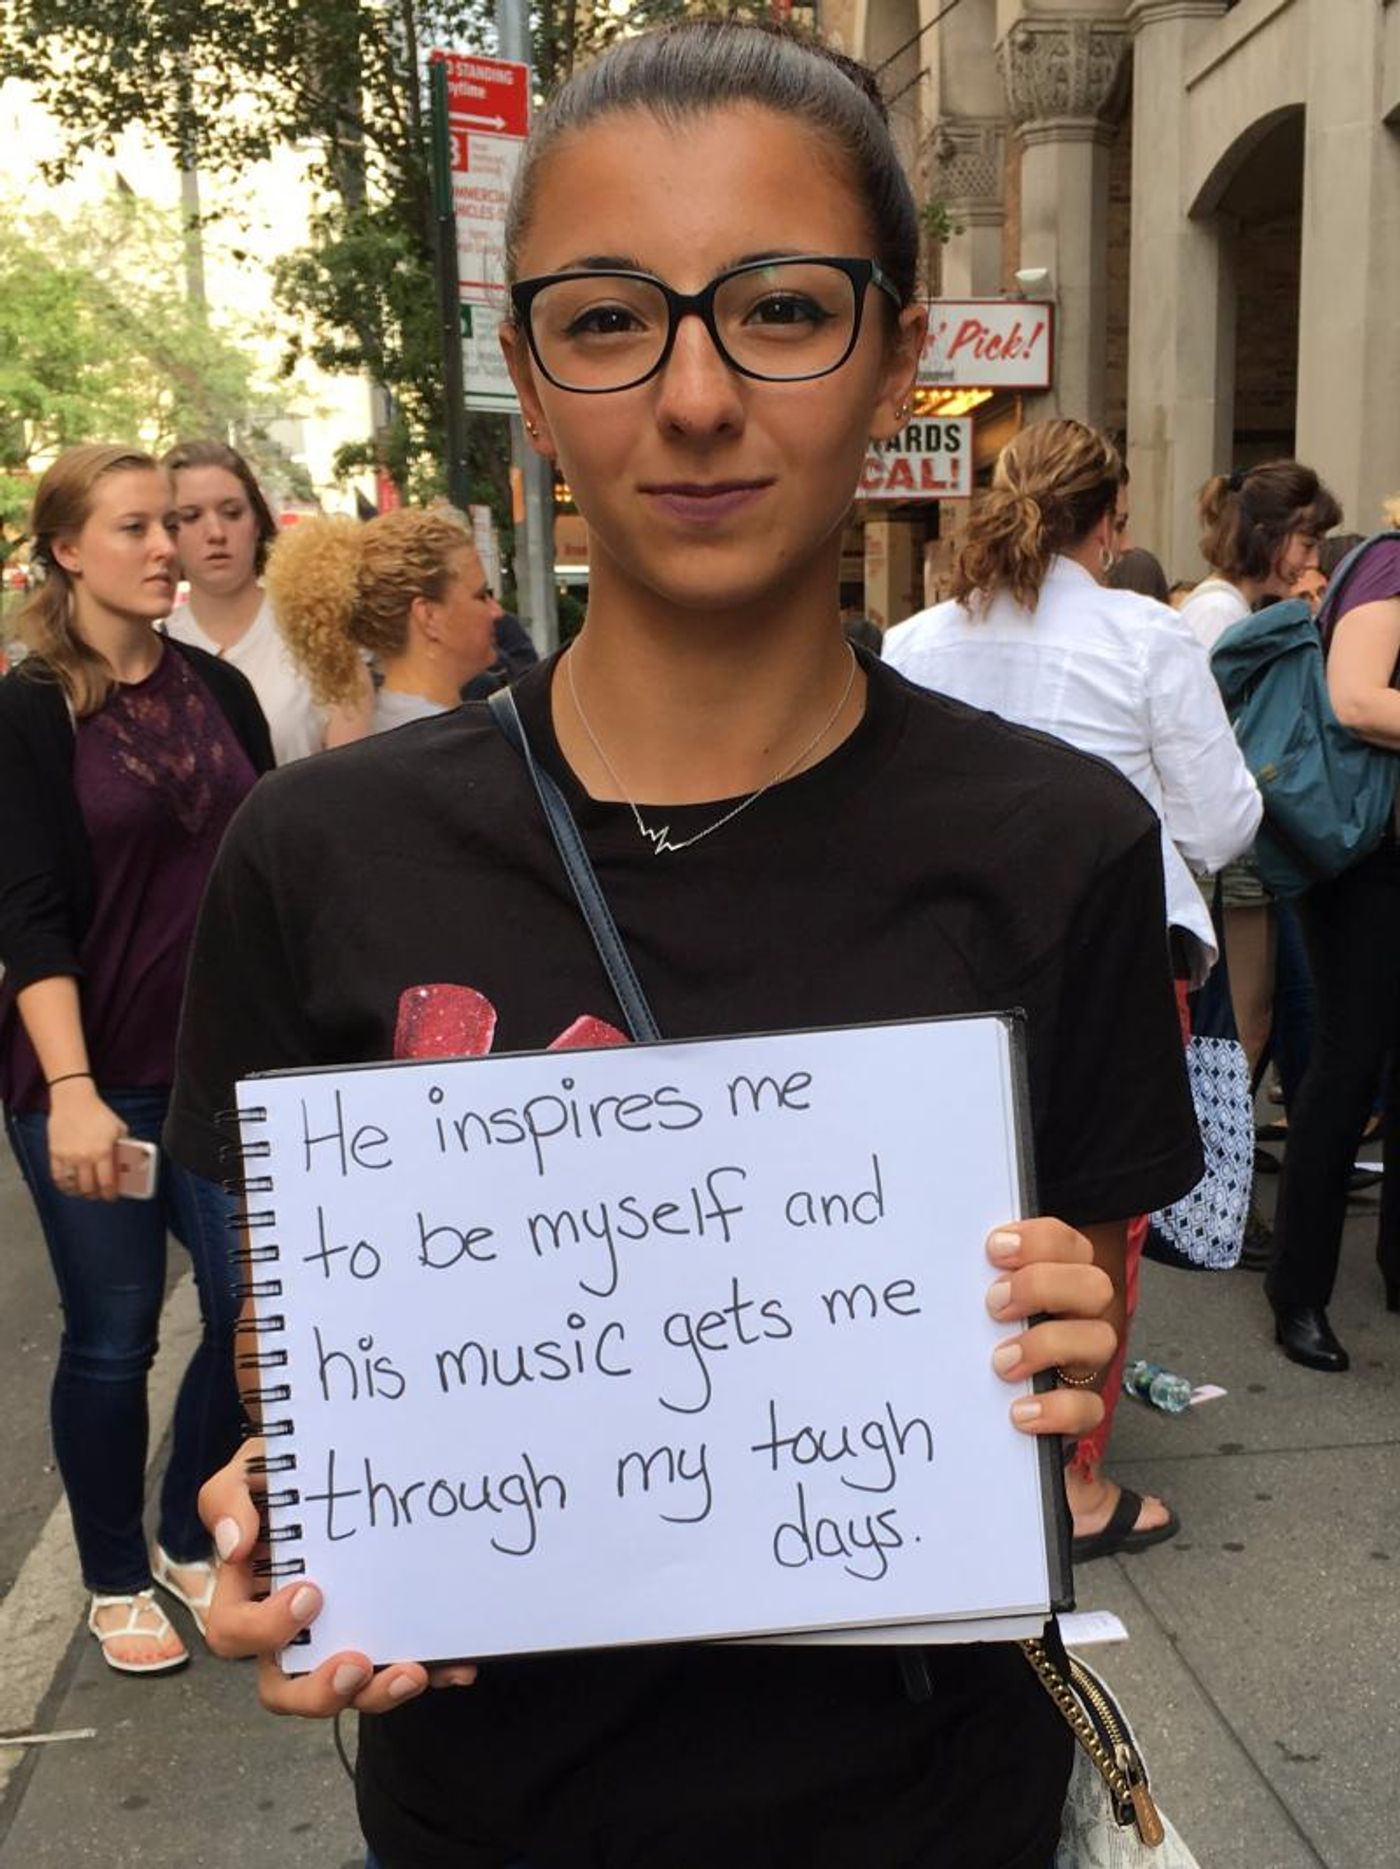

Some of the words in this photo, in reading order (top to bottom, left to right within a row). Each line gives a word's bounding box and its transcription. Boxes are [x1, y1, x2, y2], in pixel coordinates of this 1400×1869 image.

[456, 61, 514, 86] STANDING
[946, 318, 1045, 361] Pick!
[859, 457, 961, 490] CAL!
[877, 423, 961, 453] ARDS
[302, 1089, 393, 1177] He
[428, 1077, 704, 1177] inspires
[727, 1071, 813, 1117] me
[302, 1205, 381, 1280] to
[416, 1211, 497, 1270] be
[527, 1166, 747, 1298] myself
[785, 1153, 885, 1227] and
[312, 1326, 406, 1402] his
[435, 1312, 632, 1393] music
[658, 1276, 793, 1415] gets
[820, 1277, 922, 1325] me
[303, 1449, 567, 1557] through
[617, 1443, 712, 1524] my
[750, 1399, 934, 1494] tough
[773, 1481, 921, 1582] days.
